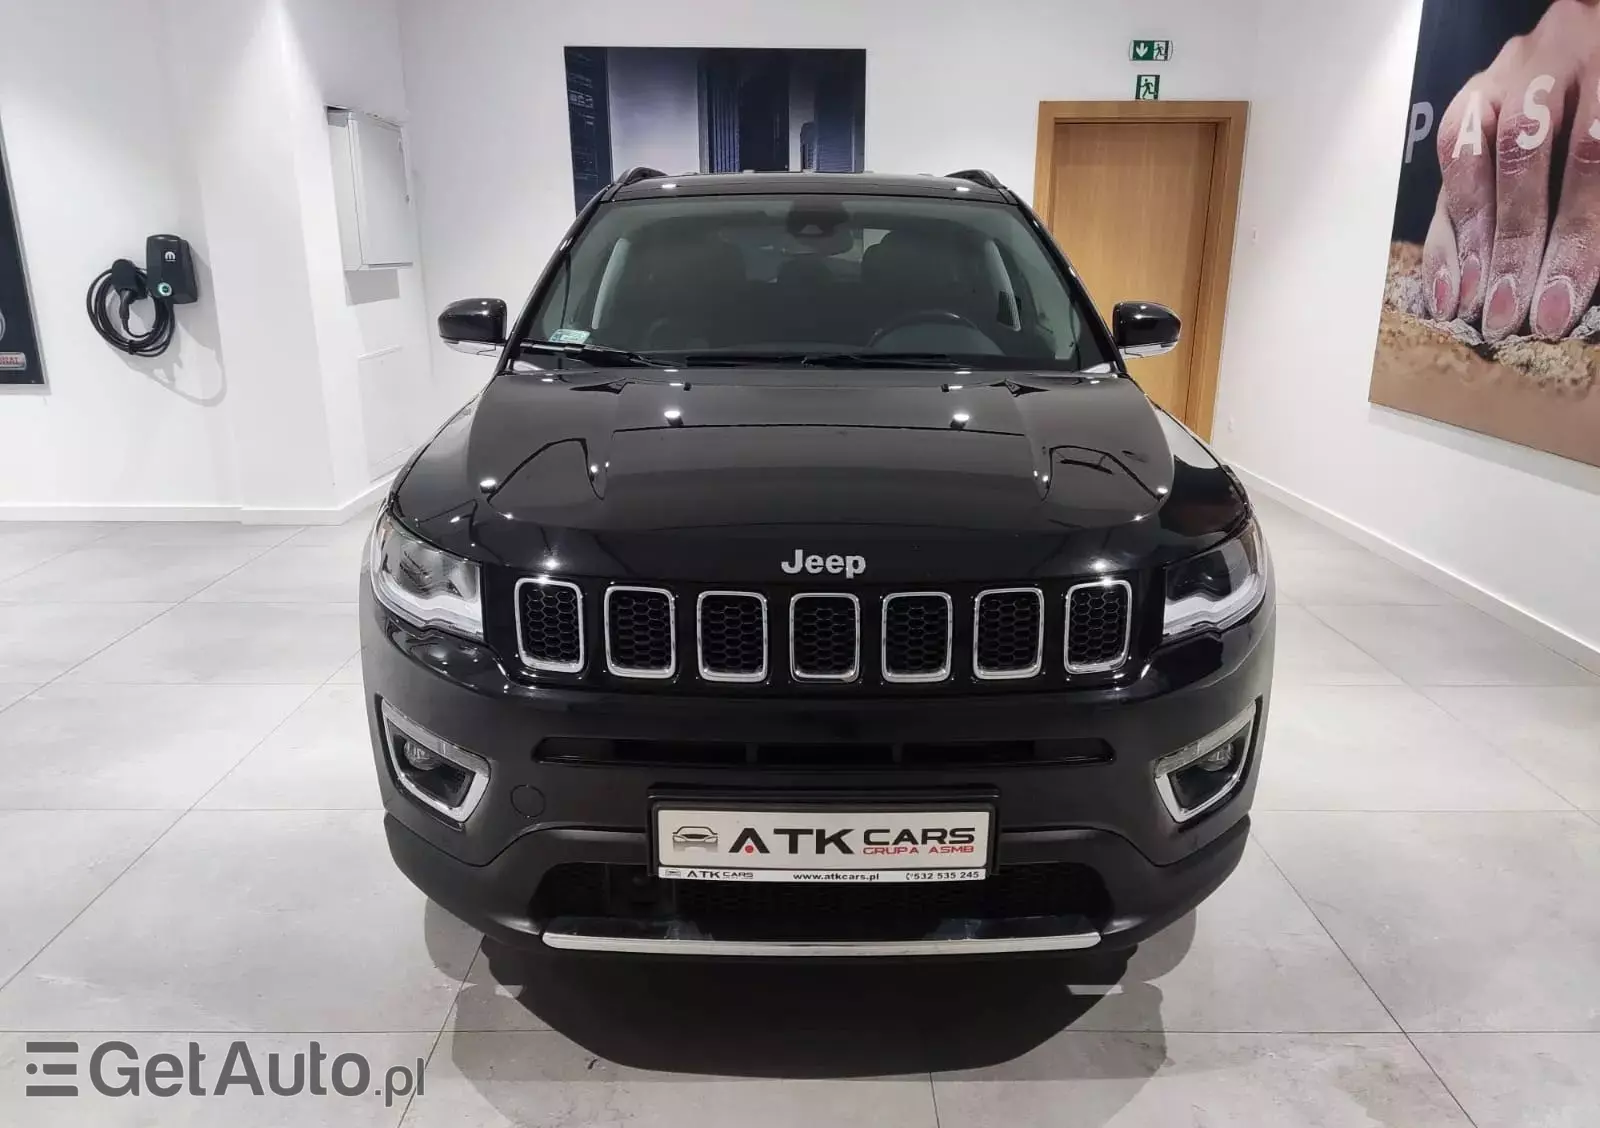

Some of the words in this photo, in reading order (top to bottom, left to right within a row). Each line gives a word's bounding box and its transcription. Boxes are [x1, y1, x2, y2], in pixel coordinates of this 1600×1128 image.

[781, 549, 866, 579] Jeep
[728, 827, 856, 855] ATK
[863, 827, 976, 846] CARS
[862, 846, 920, 855] GRUPA
[928, 845, 975, 854] ASMB
[687, 870, 720, 878] ATK
[793, 872, 880, 882] www.atkcars.pl
[937, 872, 956, 880] 535
[960, 871, 980, 879] 245
